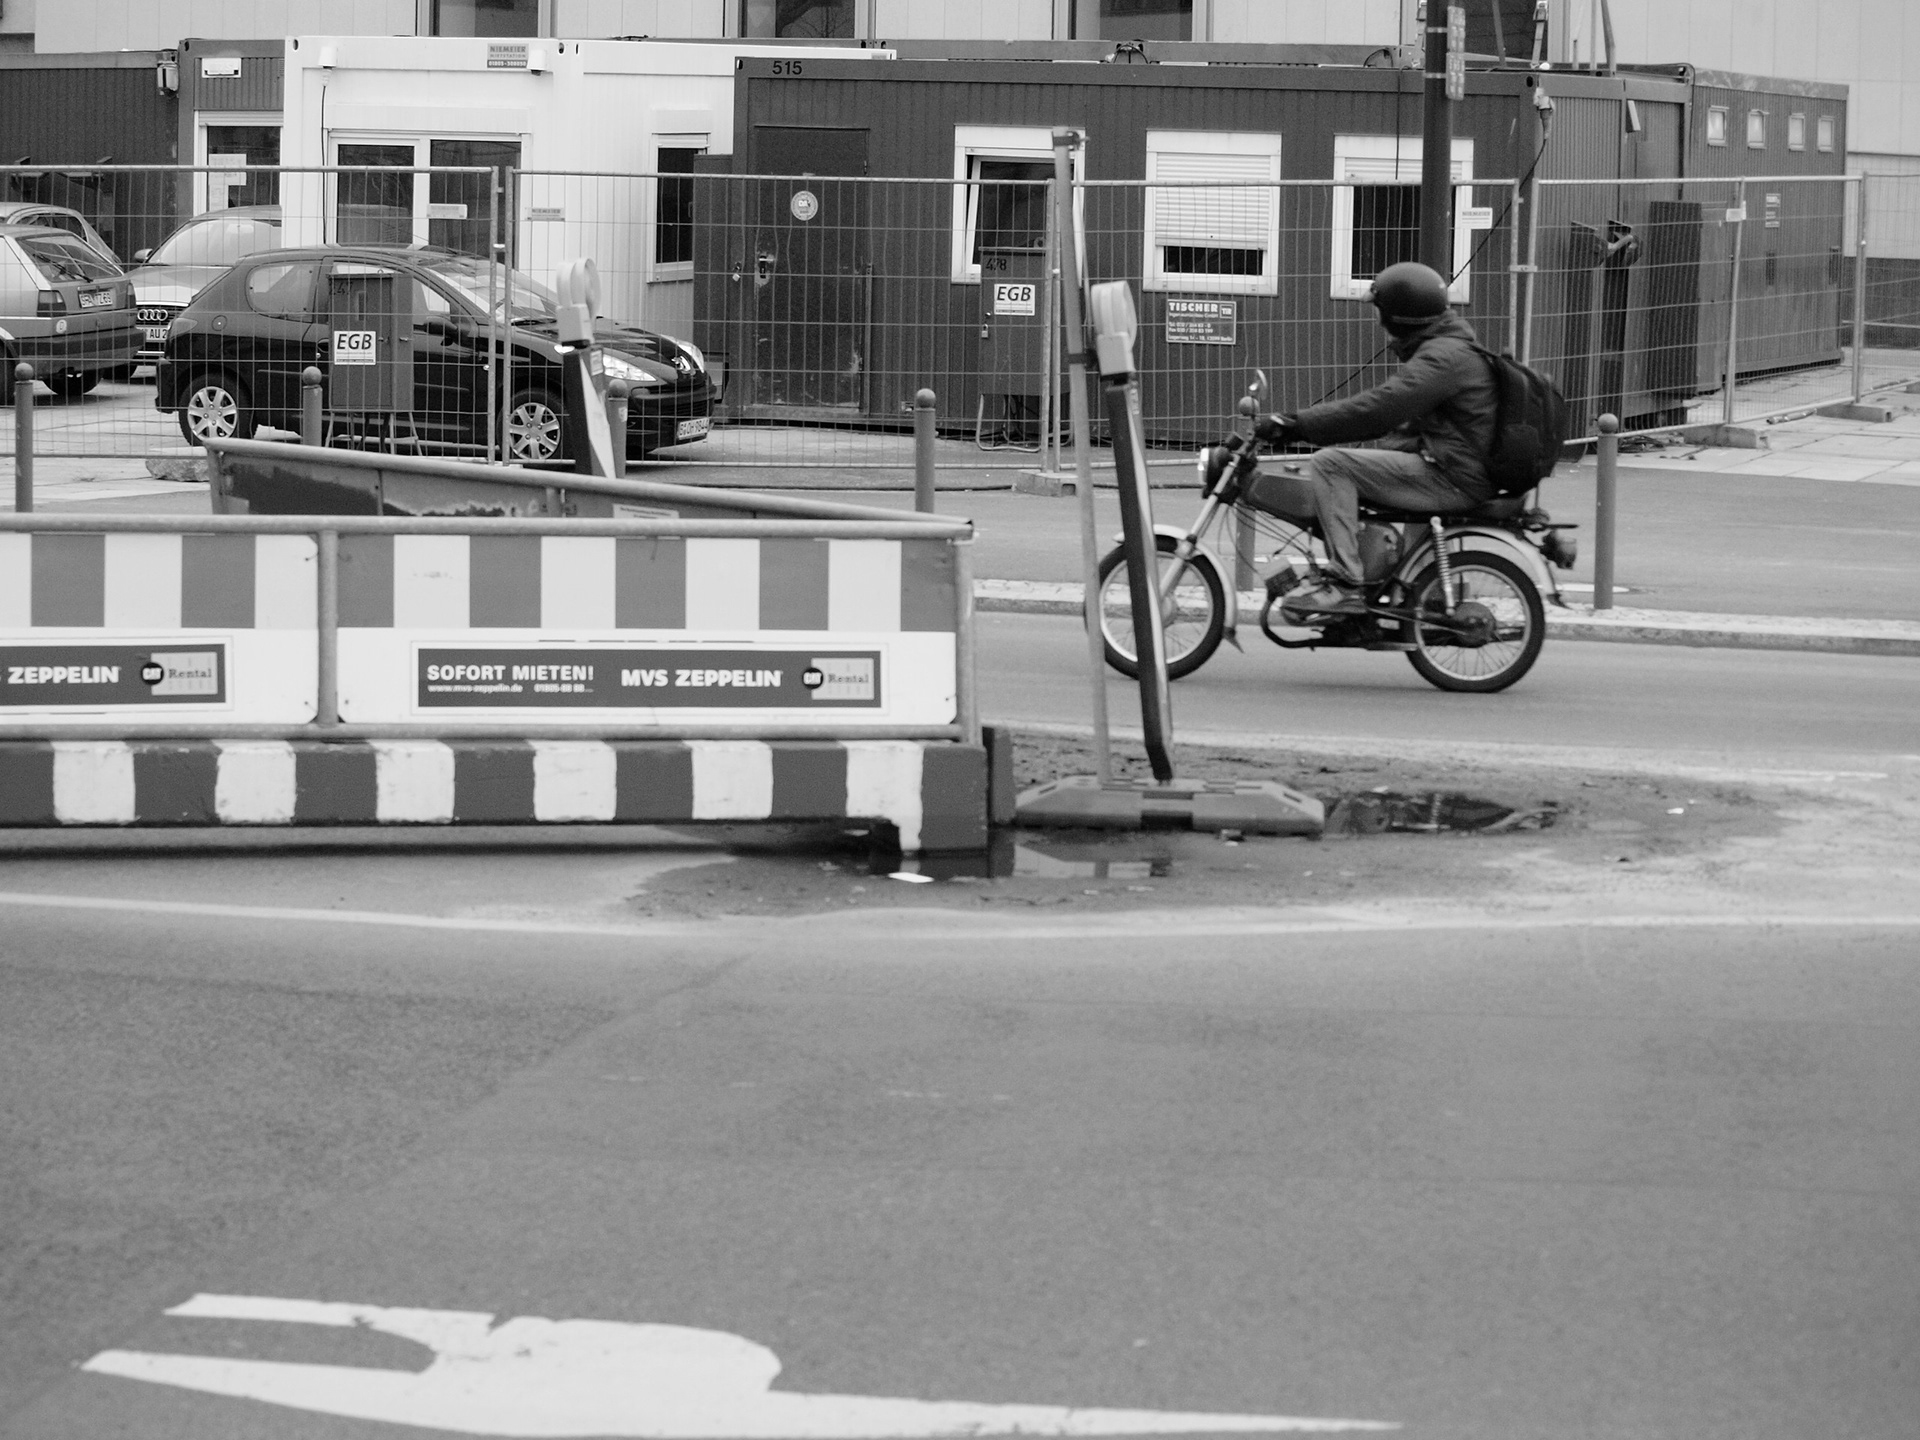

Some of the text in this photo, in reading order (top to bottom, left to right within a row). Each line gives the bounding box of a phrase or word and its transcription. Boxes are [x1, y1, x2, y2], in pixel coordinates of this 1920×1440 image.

[772, 60, 803, 75] 515
[997, 286, 1032, 301] EGB
[1169, 302, 1218, 312] TISCHER
[150, 328, 160, 339] AU
[337, 333, 372, 350] EGB
[8, 666, 120, 684] ZEPPELIN
[168, 668, 212, 679] Rental
[427, 664, 594, 681] SOFORT MIETEN!
[621, 669, 669, 687] MVS
[674, 669, 781, 687] ZEPPELIN
[828, 673, 869, 684] Rental
